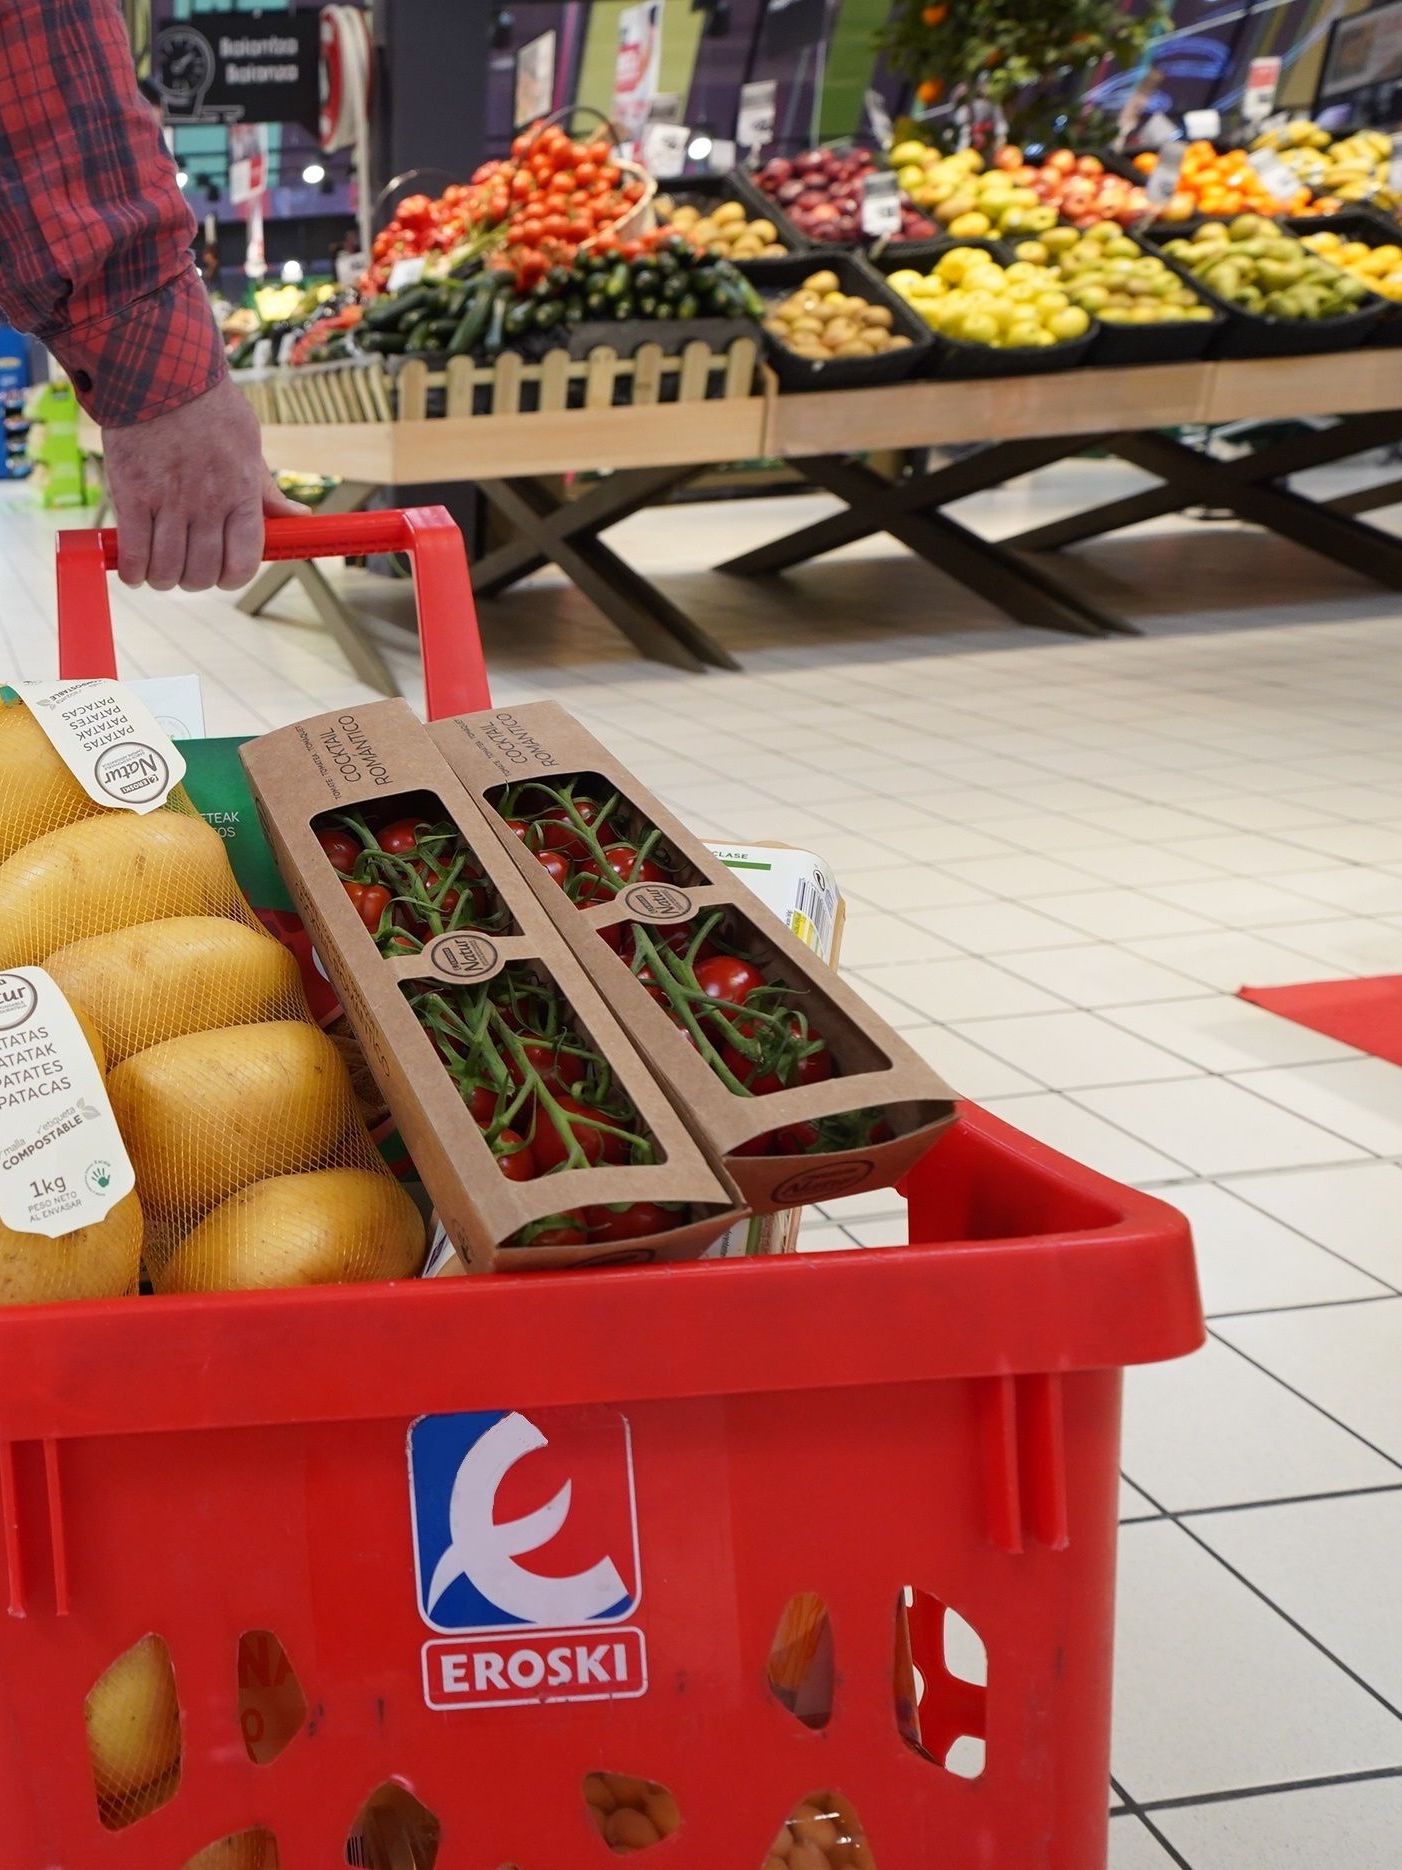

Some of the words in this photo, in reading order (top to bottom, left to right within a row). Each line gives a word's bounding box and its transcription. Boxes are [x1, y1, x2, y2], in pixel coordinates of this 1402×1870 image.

[61, 696, 116, 721] PATACAS
[69, 705, 122, 730] PATATES
[75, 714, 129, 741] PATATAK
[83, 724, 135, 752] PATATAS
[319, 727, 361, 782] COCKTAIL
[479, 721, 528, 764] COCKTAIL
[105, 754, 157, 784] Natur
[121, 778, 149, 794] EROSKI
[214, 826, 236, 838] OS
[646, 889, 679, 914] Natur
[454, 939, 484, 971] Natur
[42, 1106, 76, 1131] etiqueta
[2, 1114, 84, 1171] COMPOSTABLE
[29, 1176, 67, 1198] 1kg
[28, 1199, 52, 1213] PESO
[54, 1191, 77, 1204] NETO
[29, 1214, 41, 1223] AL
[42, 1199, 82, 1219] ENVASAR
[440, 1643, 628, 1693] EROSKI
